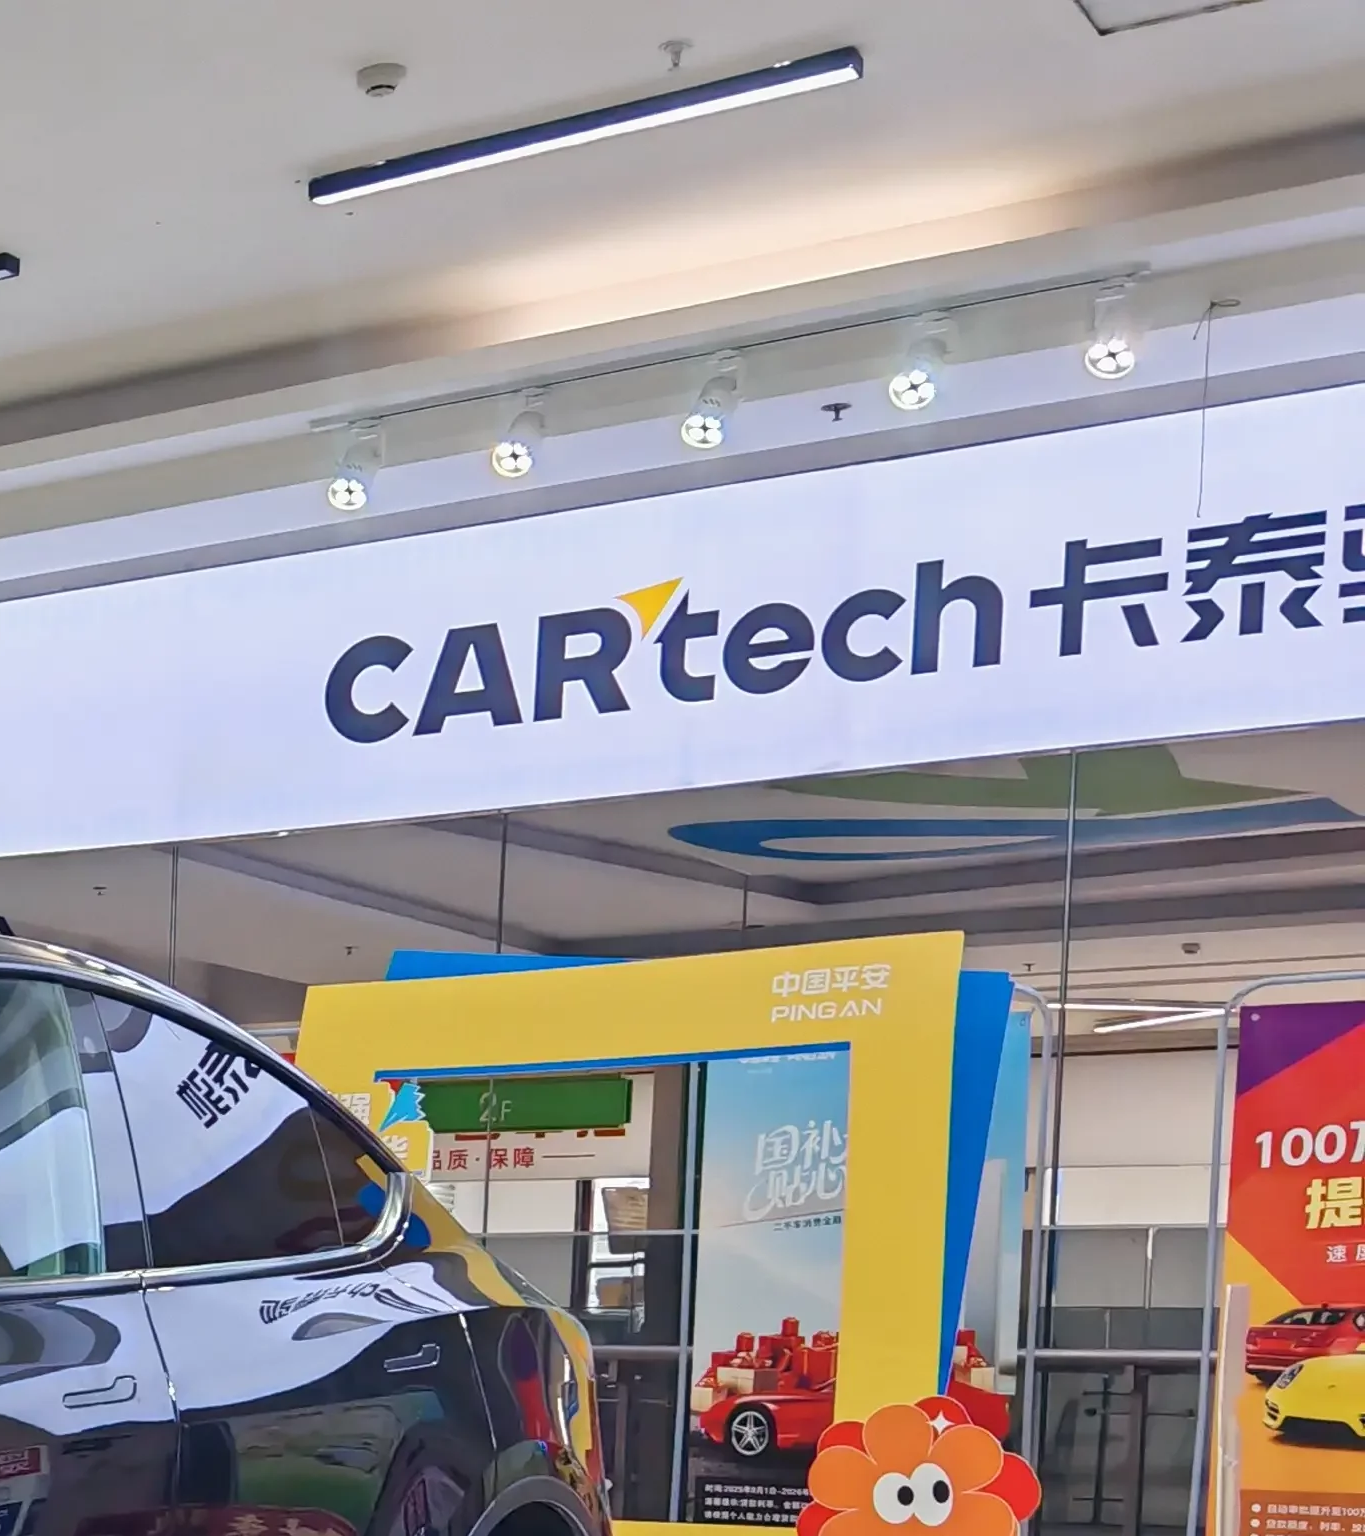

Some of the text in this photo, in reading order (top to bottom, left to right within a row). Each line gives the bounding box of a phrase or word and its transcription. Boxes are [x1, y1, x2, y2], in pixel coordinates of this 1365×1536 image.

[325, 559, 1005, 745] CARtech
[771, 963, 892, 998] 中国平安
[755, 1120, 848, 1176] 国补
